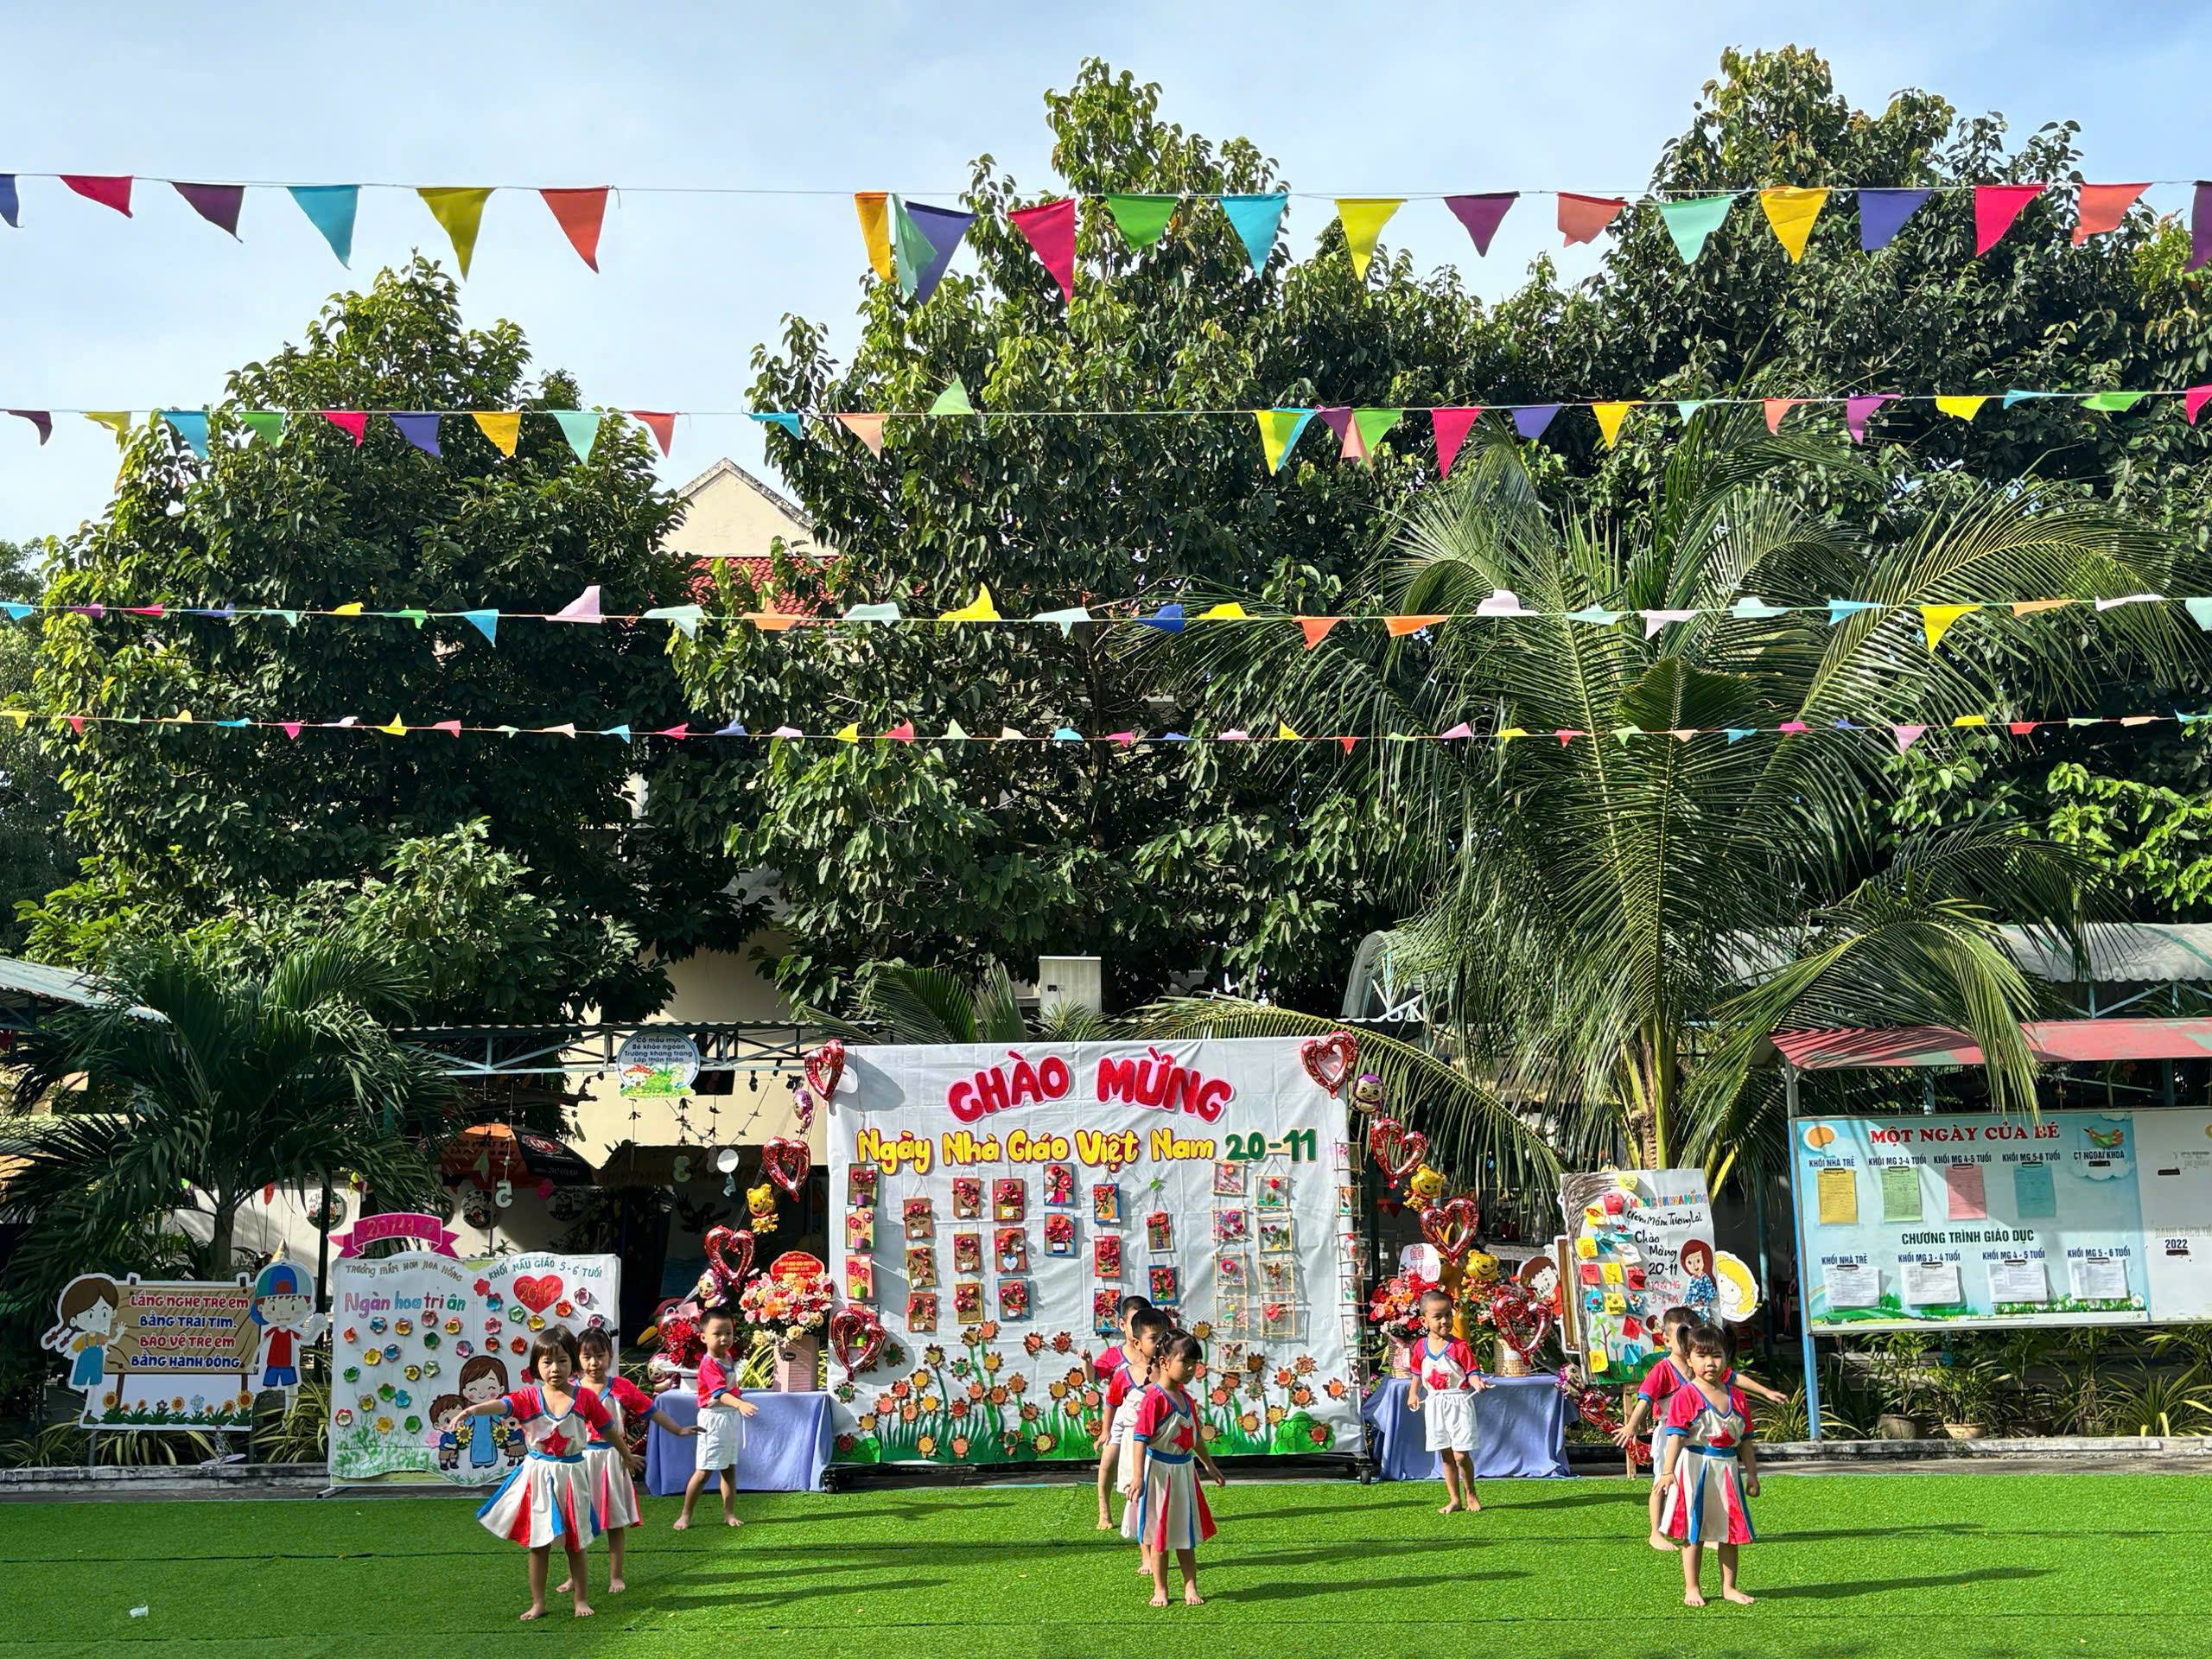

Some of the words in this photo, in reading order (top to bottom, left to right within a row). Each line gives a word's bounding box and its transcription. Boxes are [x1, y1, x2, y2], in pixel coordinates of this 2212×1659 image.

[947, 1050, 1071, 1123] CHÀO
[1097, 1046, 1234, 1122] MỪNG
[1870, 1126, 1914, 1147] MỘT
[1919, 1124, 1978, 1142] NGÀY
[1984, 1121, 2028, 1140] CỦA
[856, 1128, 931, 1175] Ngày
[942, 1129, 1001, 1166] Nhà
[1007, 1128, 1071, 1163] Giáo
[1075, 1128, 1140, 1173] Việt
[1150, 1128, 1215, 1162] Nam
[1225, 1128, 1316, 1162] 20-11
[2020, 1153, 2031, 1161] MG
[2032, 1153, 2044, 1161] 5-6
[1886, 1157, 1897, 1166] MG
[1635, 1229, 1660, 1243] Chào
[1902, 1231, 1945, 1244] CHƯƠNG
[1948, 1229, 1980, 1243] TRÌNH
[1984, 1229, 2009, 1243] GIÁO
[2012, 1230, 2034, 1244] DỤC
[2164, 1238, 2188, 1249] 2022
[1916, 1253, 1927, 1262] MG
[1945, 1249, 1961, 1261] TUỔI
[2030, 1247, 2045, 1258] TUỔI
[2115, 1245, 2131, 1256] TUỔI
[1855, 1253, 1868, 1264] TRẺ
[488, 1262, 507, 1281] KHỐI
[534, 1257, 555, 1268] GIÁO
[582, 1266, 602, 1278] TUỔI
[1649, 1262, 1678, 1275] 20-11
[345, 1291, 391, 1319] Ngàn
[394, 1290, 423, 1309] hoa
[447, 1293, 467, 1312] ân
[140, 1333, 166, 1347] BẢO
